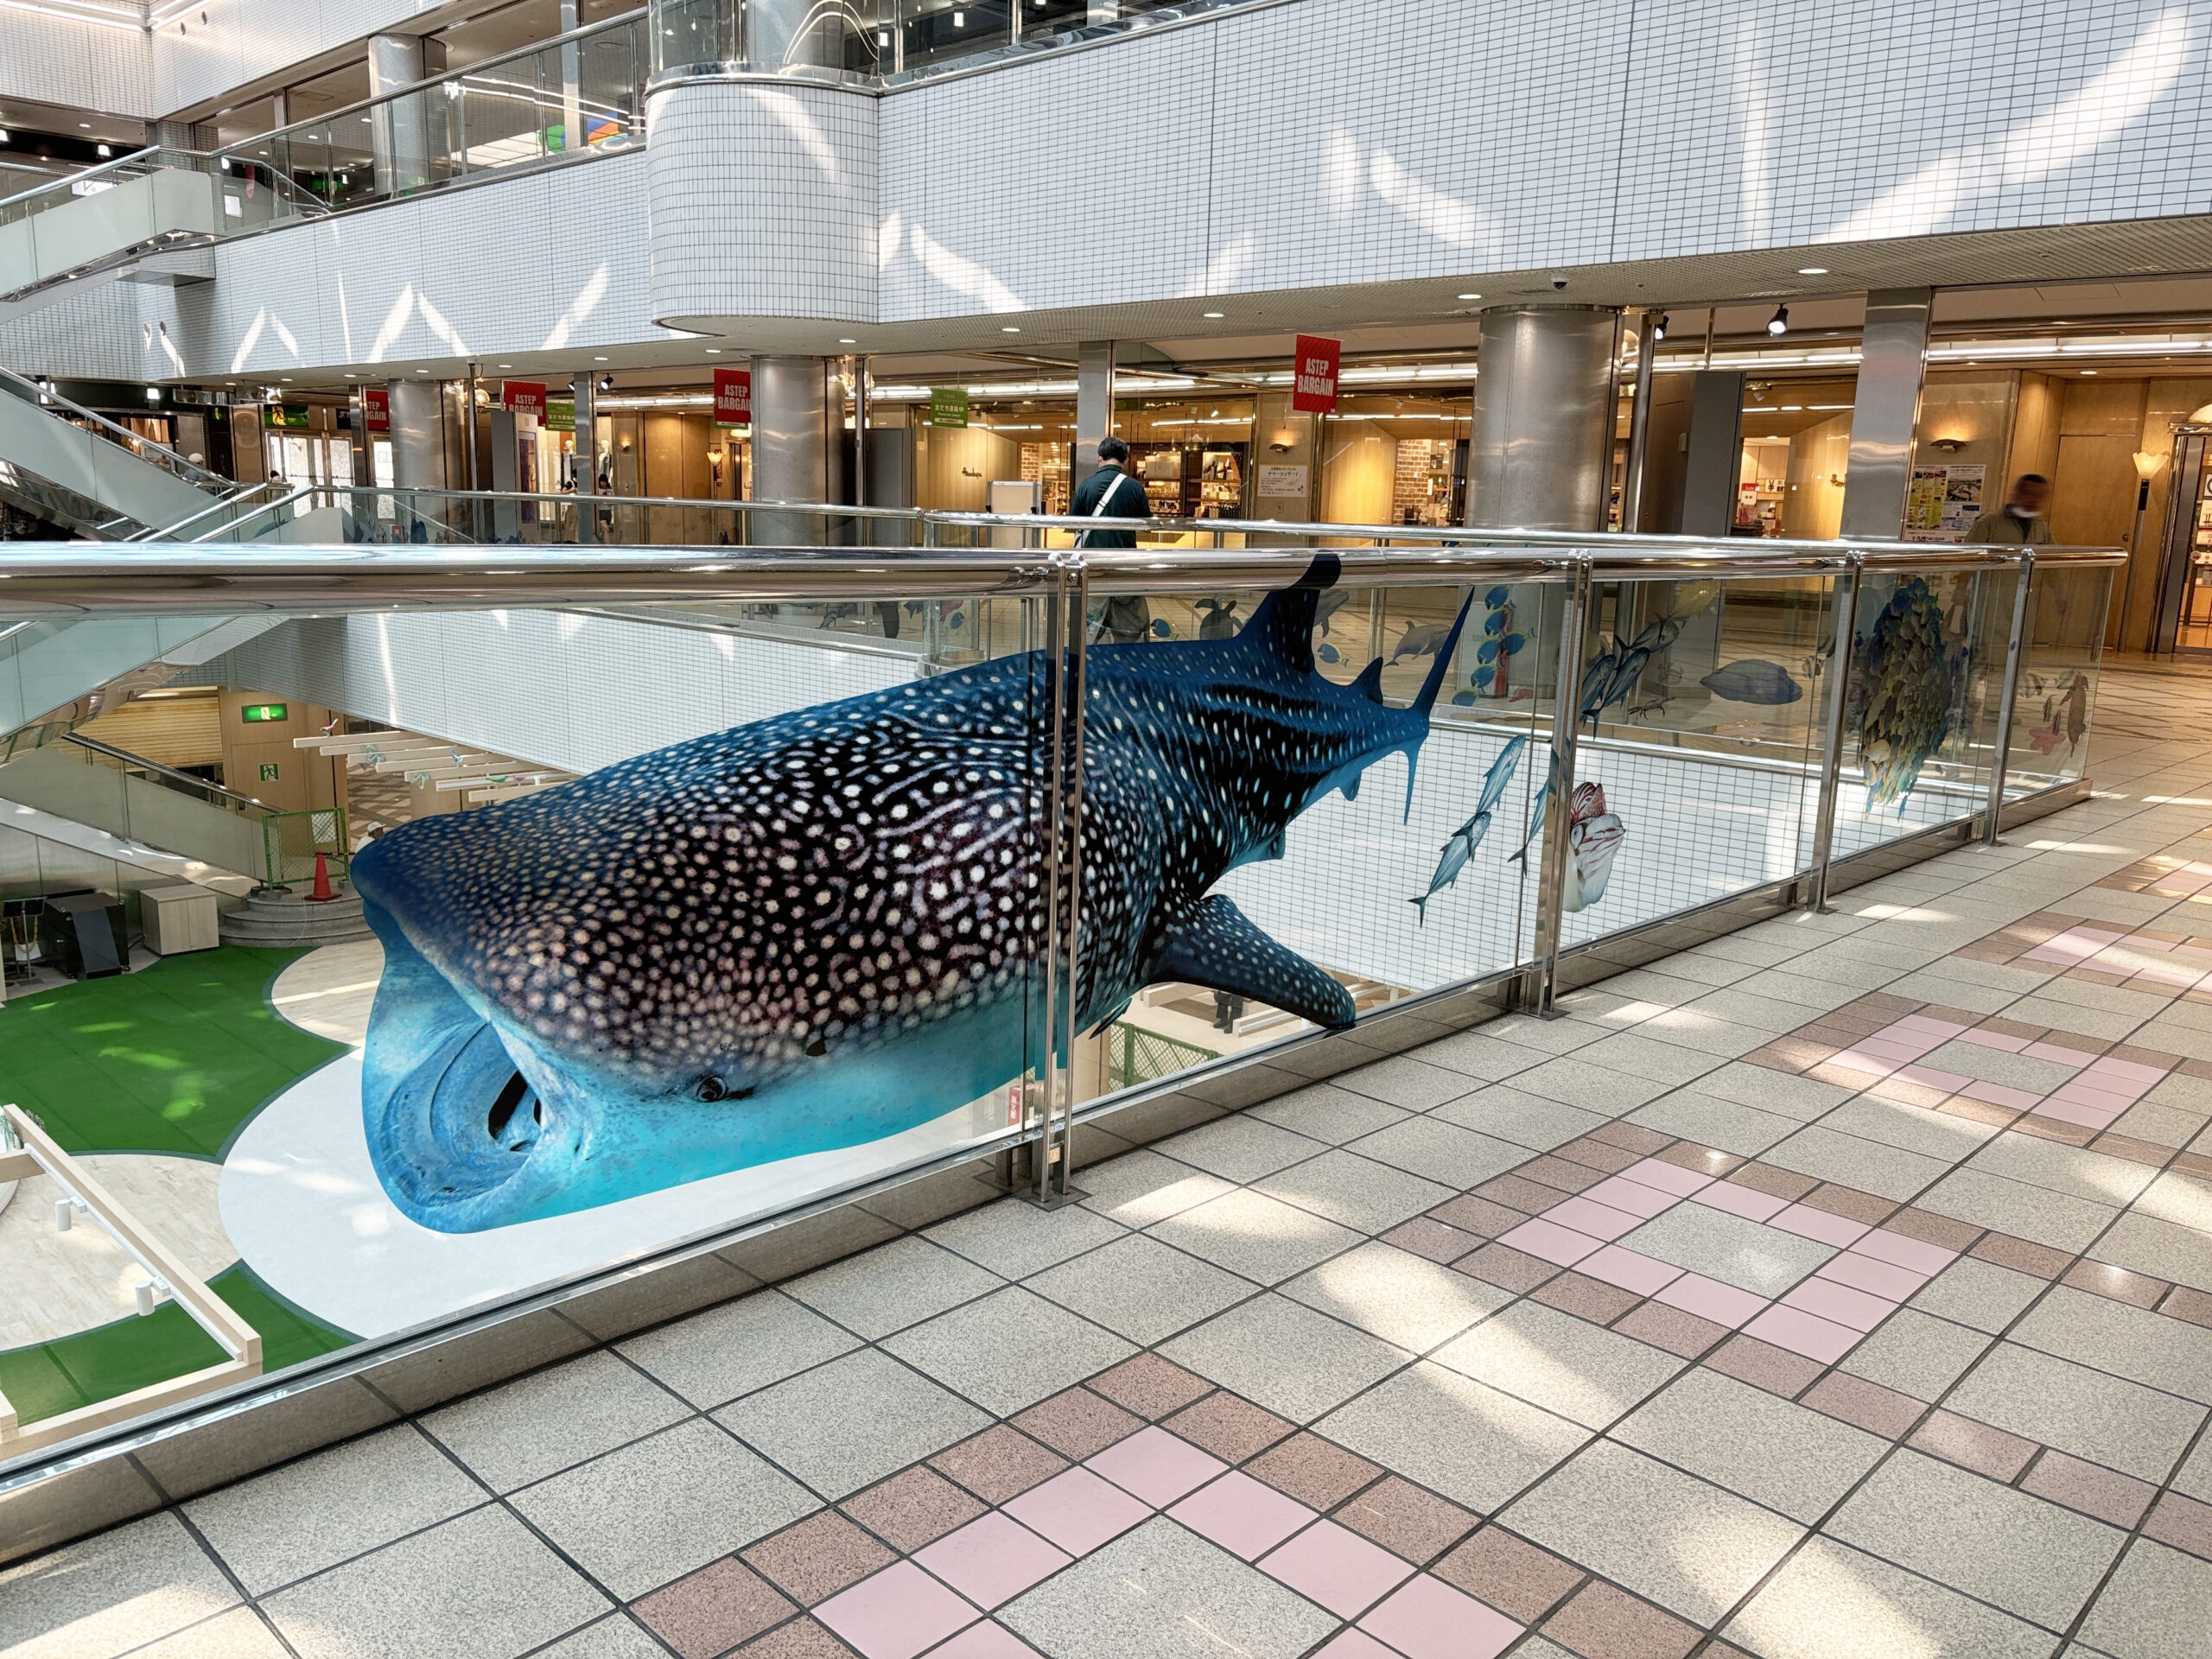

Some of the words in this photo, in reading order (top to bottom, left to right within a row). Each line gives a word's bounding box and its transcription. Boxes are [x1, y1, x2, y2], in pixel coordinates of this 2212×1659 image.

[1306, 357, 1329, 376] ASTEP
[725, 385, 747, 397] ASTEP
[1297, 374, 1334, 397] BARGAIN
[366, 401, 380, 410] TEP
[515, 394, 536, 405] ASTEP
[366, 410, 387, 422] GAIN
